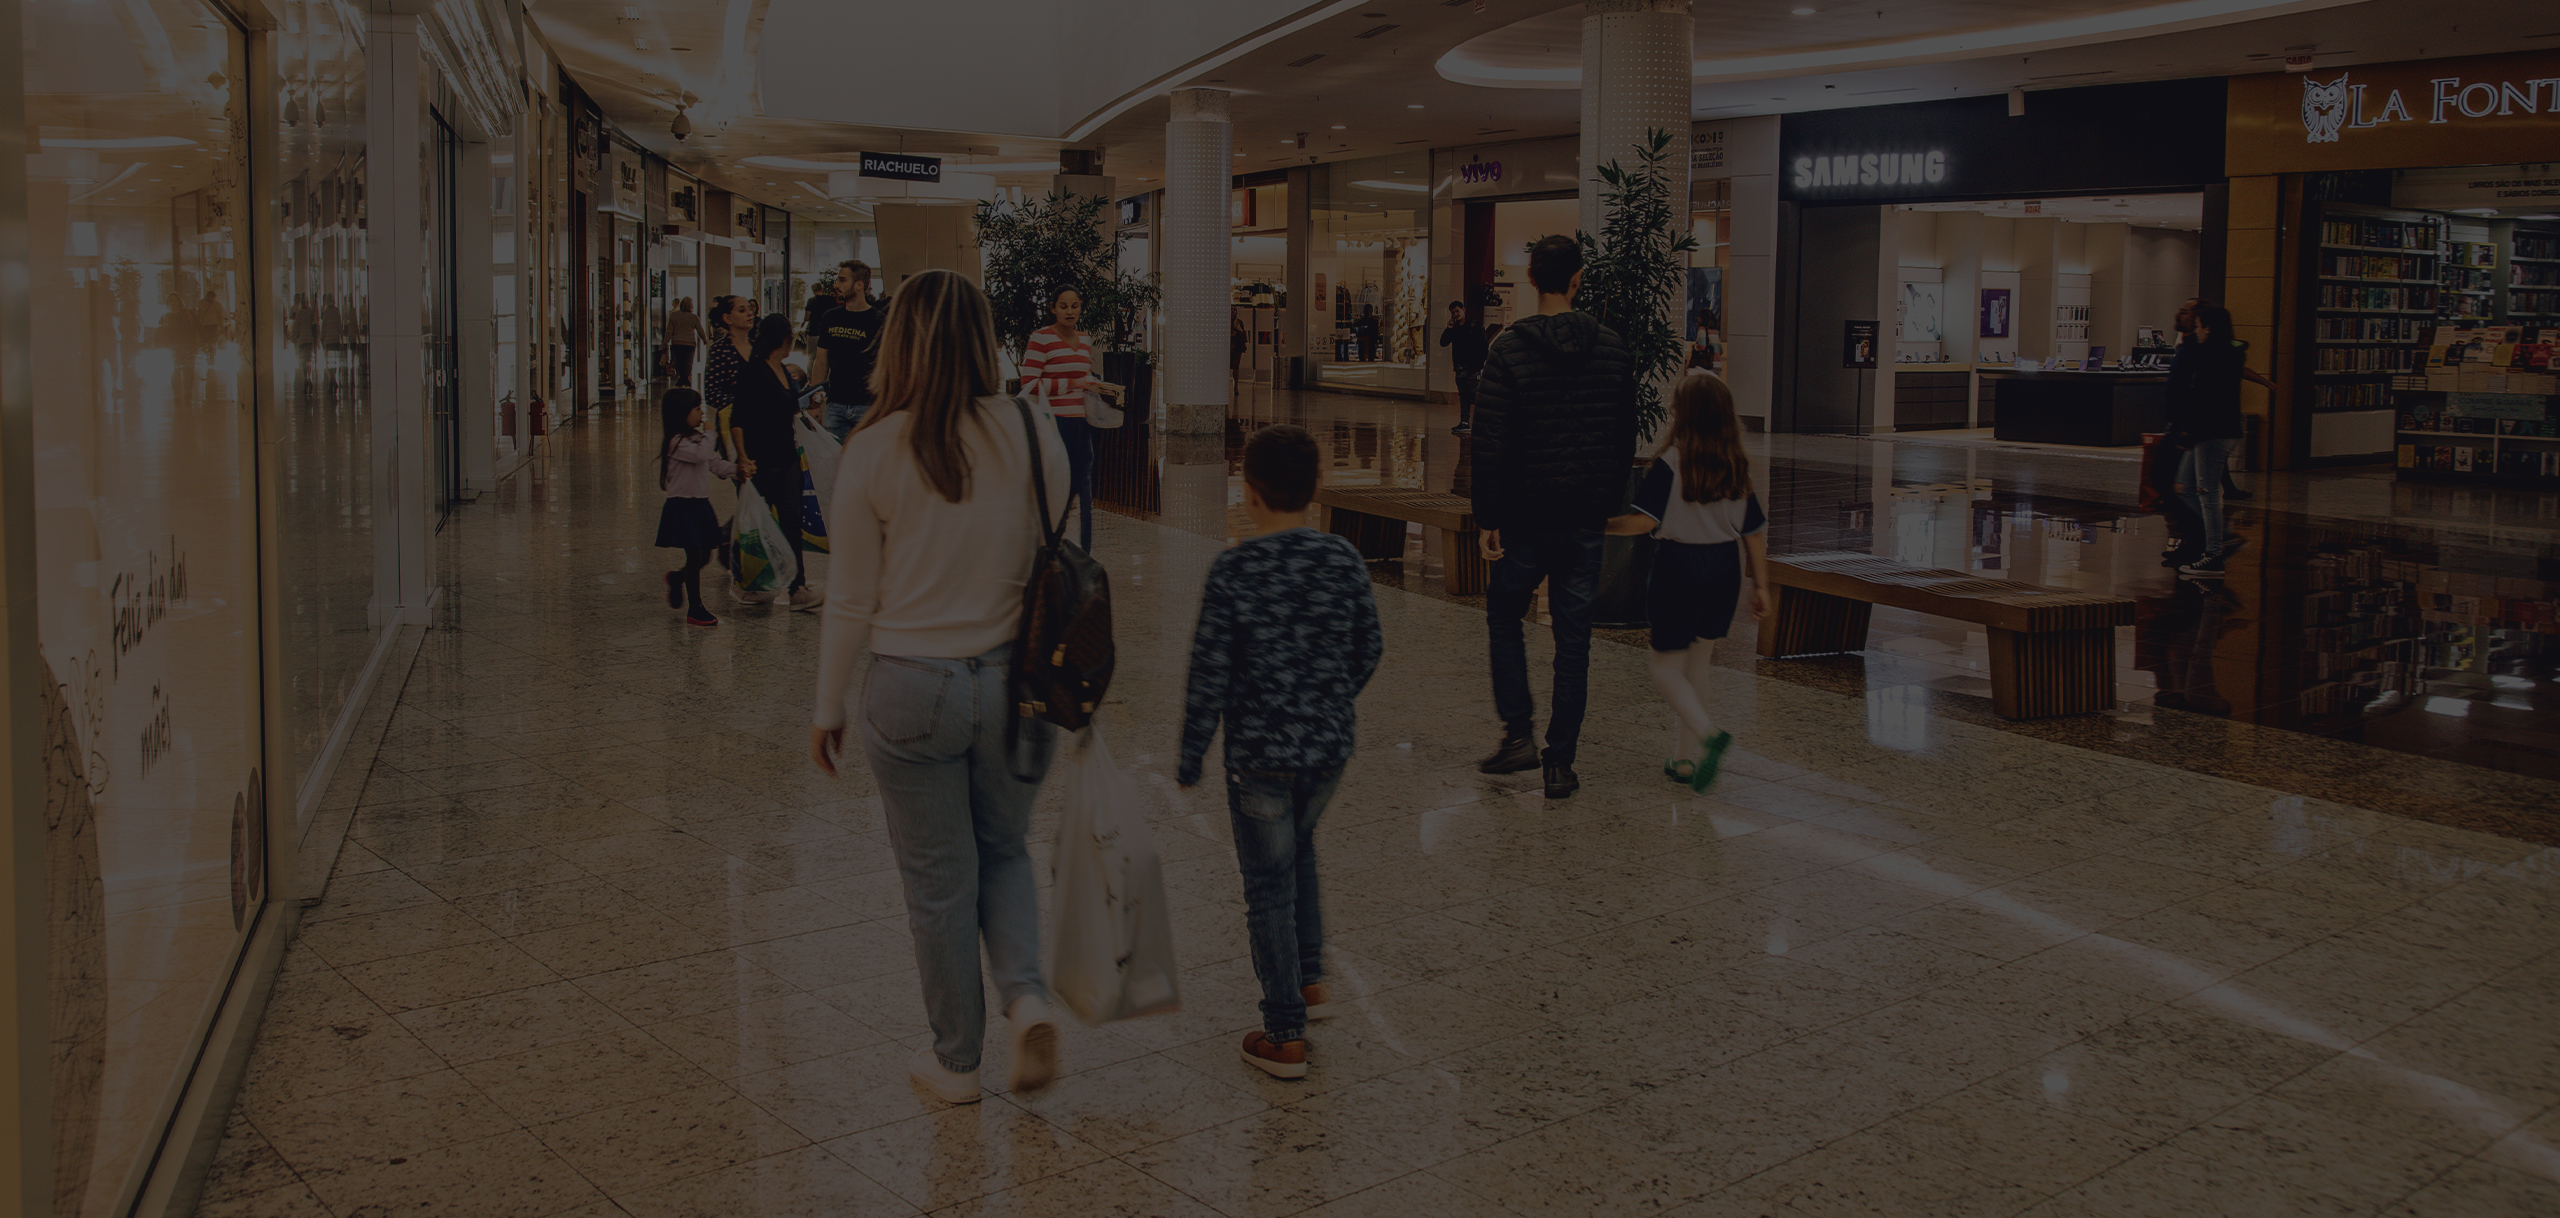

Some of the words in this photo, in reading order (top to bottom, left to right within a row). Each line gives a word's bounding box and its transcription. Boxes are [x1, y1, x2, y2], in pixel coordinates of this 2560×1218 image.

[2347, 83, 2414, 129] LA
[2428, 76, 2560, 125] FONT
[864, 158, 939, 176] RIACHUELO
[1460, 154, 1502, 184] vivo
[1794, 150, 1946, 188] SAMSUNG
[2497, 190, 2503, 198] E
[2512, 180, 2522, 188] OS
[2523, 179, 2542, 187] MAIS
[828, 326, 867, 339] MEDICINA
[110, 571, 143, 685] Feliz
[147, 549, 167, 632] dia
[169, 533, 188, 610] das
[140, 677, 171, 780] mães
